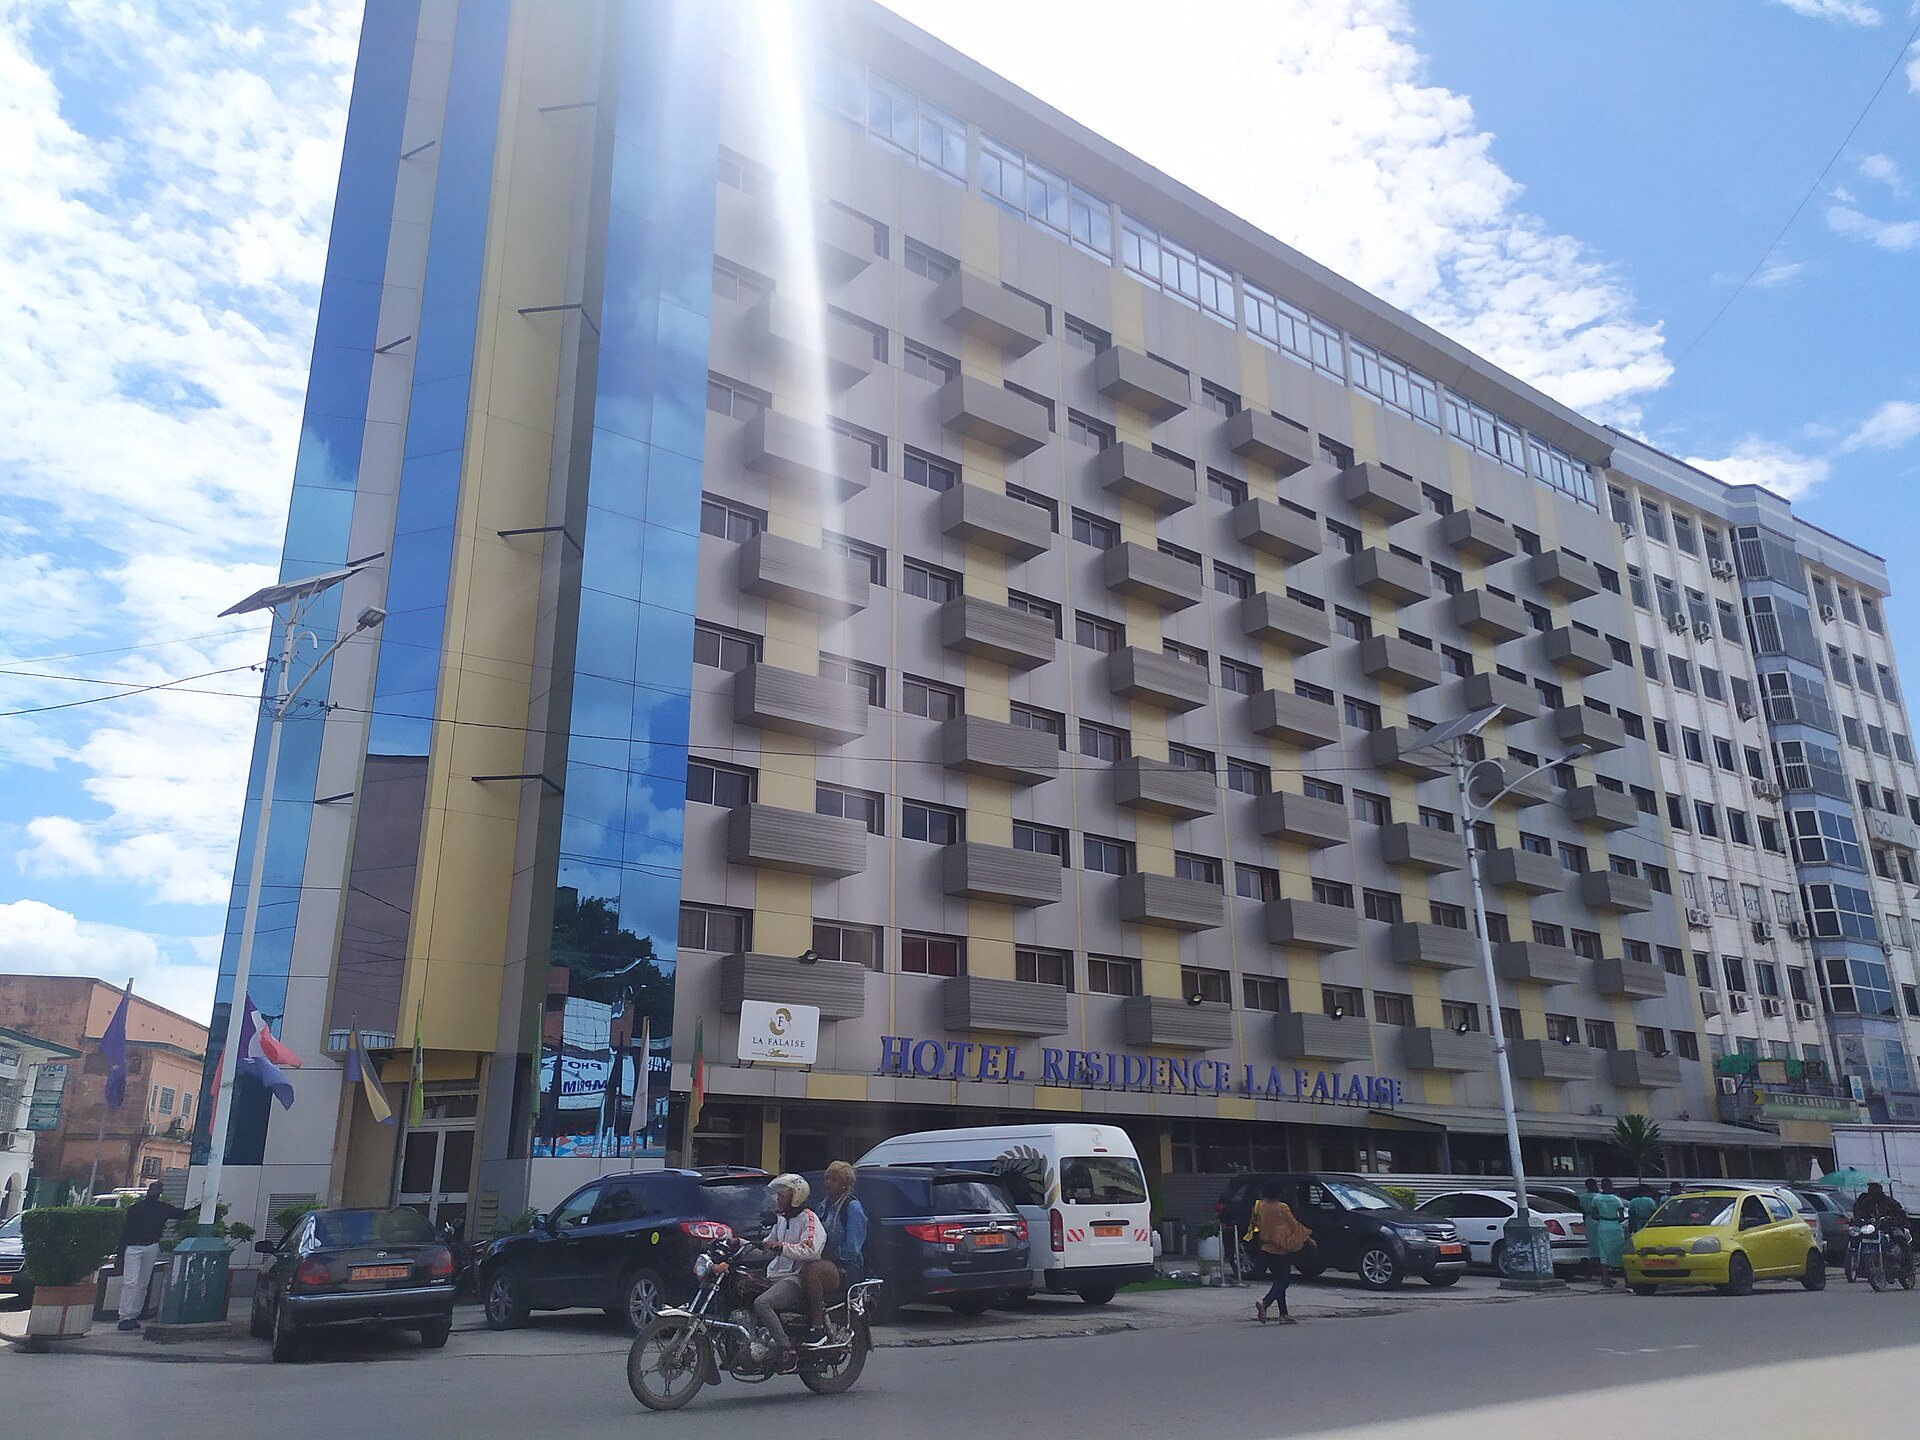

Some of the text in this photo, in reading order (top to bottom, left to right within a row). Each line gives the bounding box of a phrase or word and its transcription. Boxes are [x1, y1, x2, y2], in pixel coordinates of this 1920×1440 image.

[777, 1016, 784, 1027] F
[752, 1036, 806, 1048] LA FALAISE
[42, 1064, 64, 1073] VISA
[880, 1035, 1404, 1105] HOTEL RESIDENCE LA FALAISE
[1797, 1096, 1841, 1109] CAMEROUN
